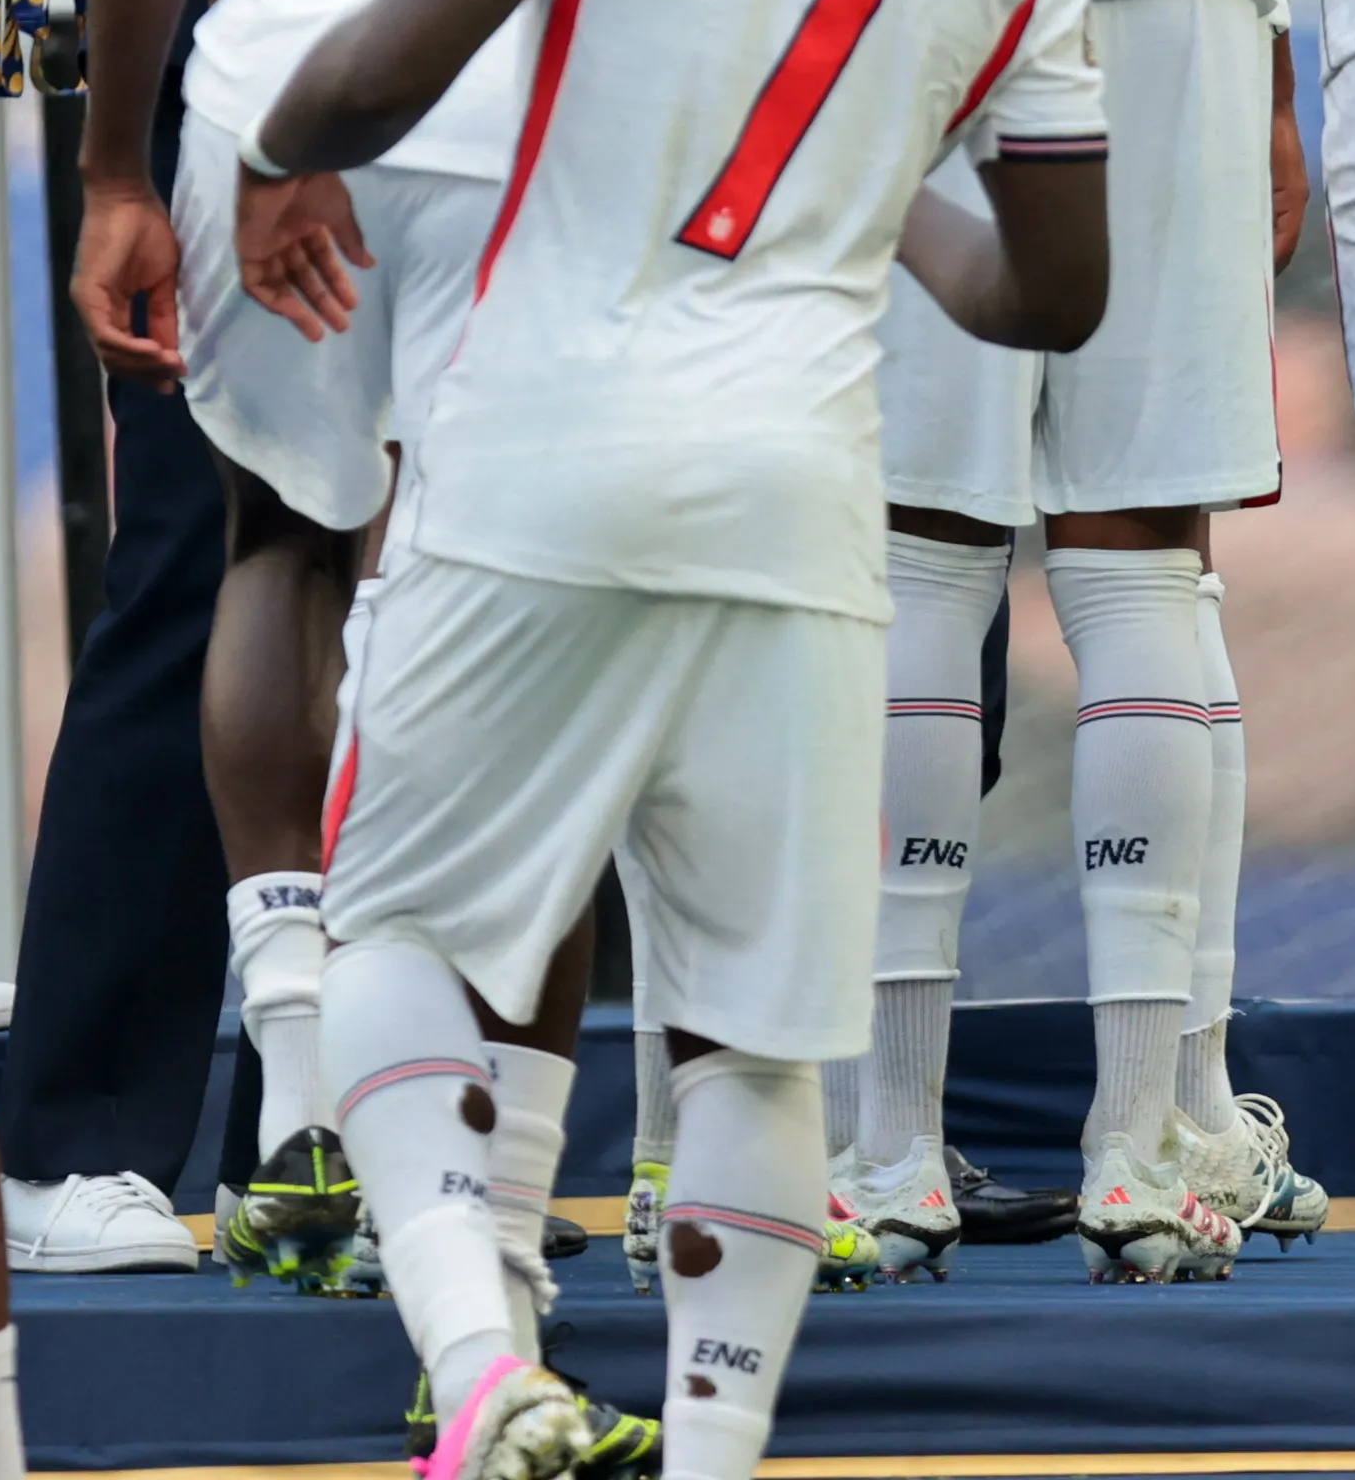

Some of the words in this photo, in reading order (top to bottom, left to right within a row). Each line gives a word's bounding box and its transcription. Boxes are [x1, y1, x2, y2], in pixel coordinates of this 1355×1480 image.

[900, 837, 969, 869] ENG
[1085, 836, 1149, 871] ENG
[691, 1338, 763, 1375] ENG
